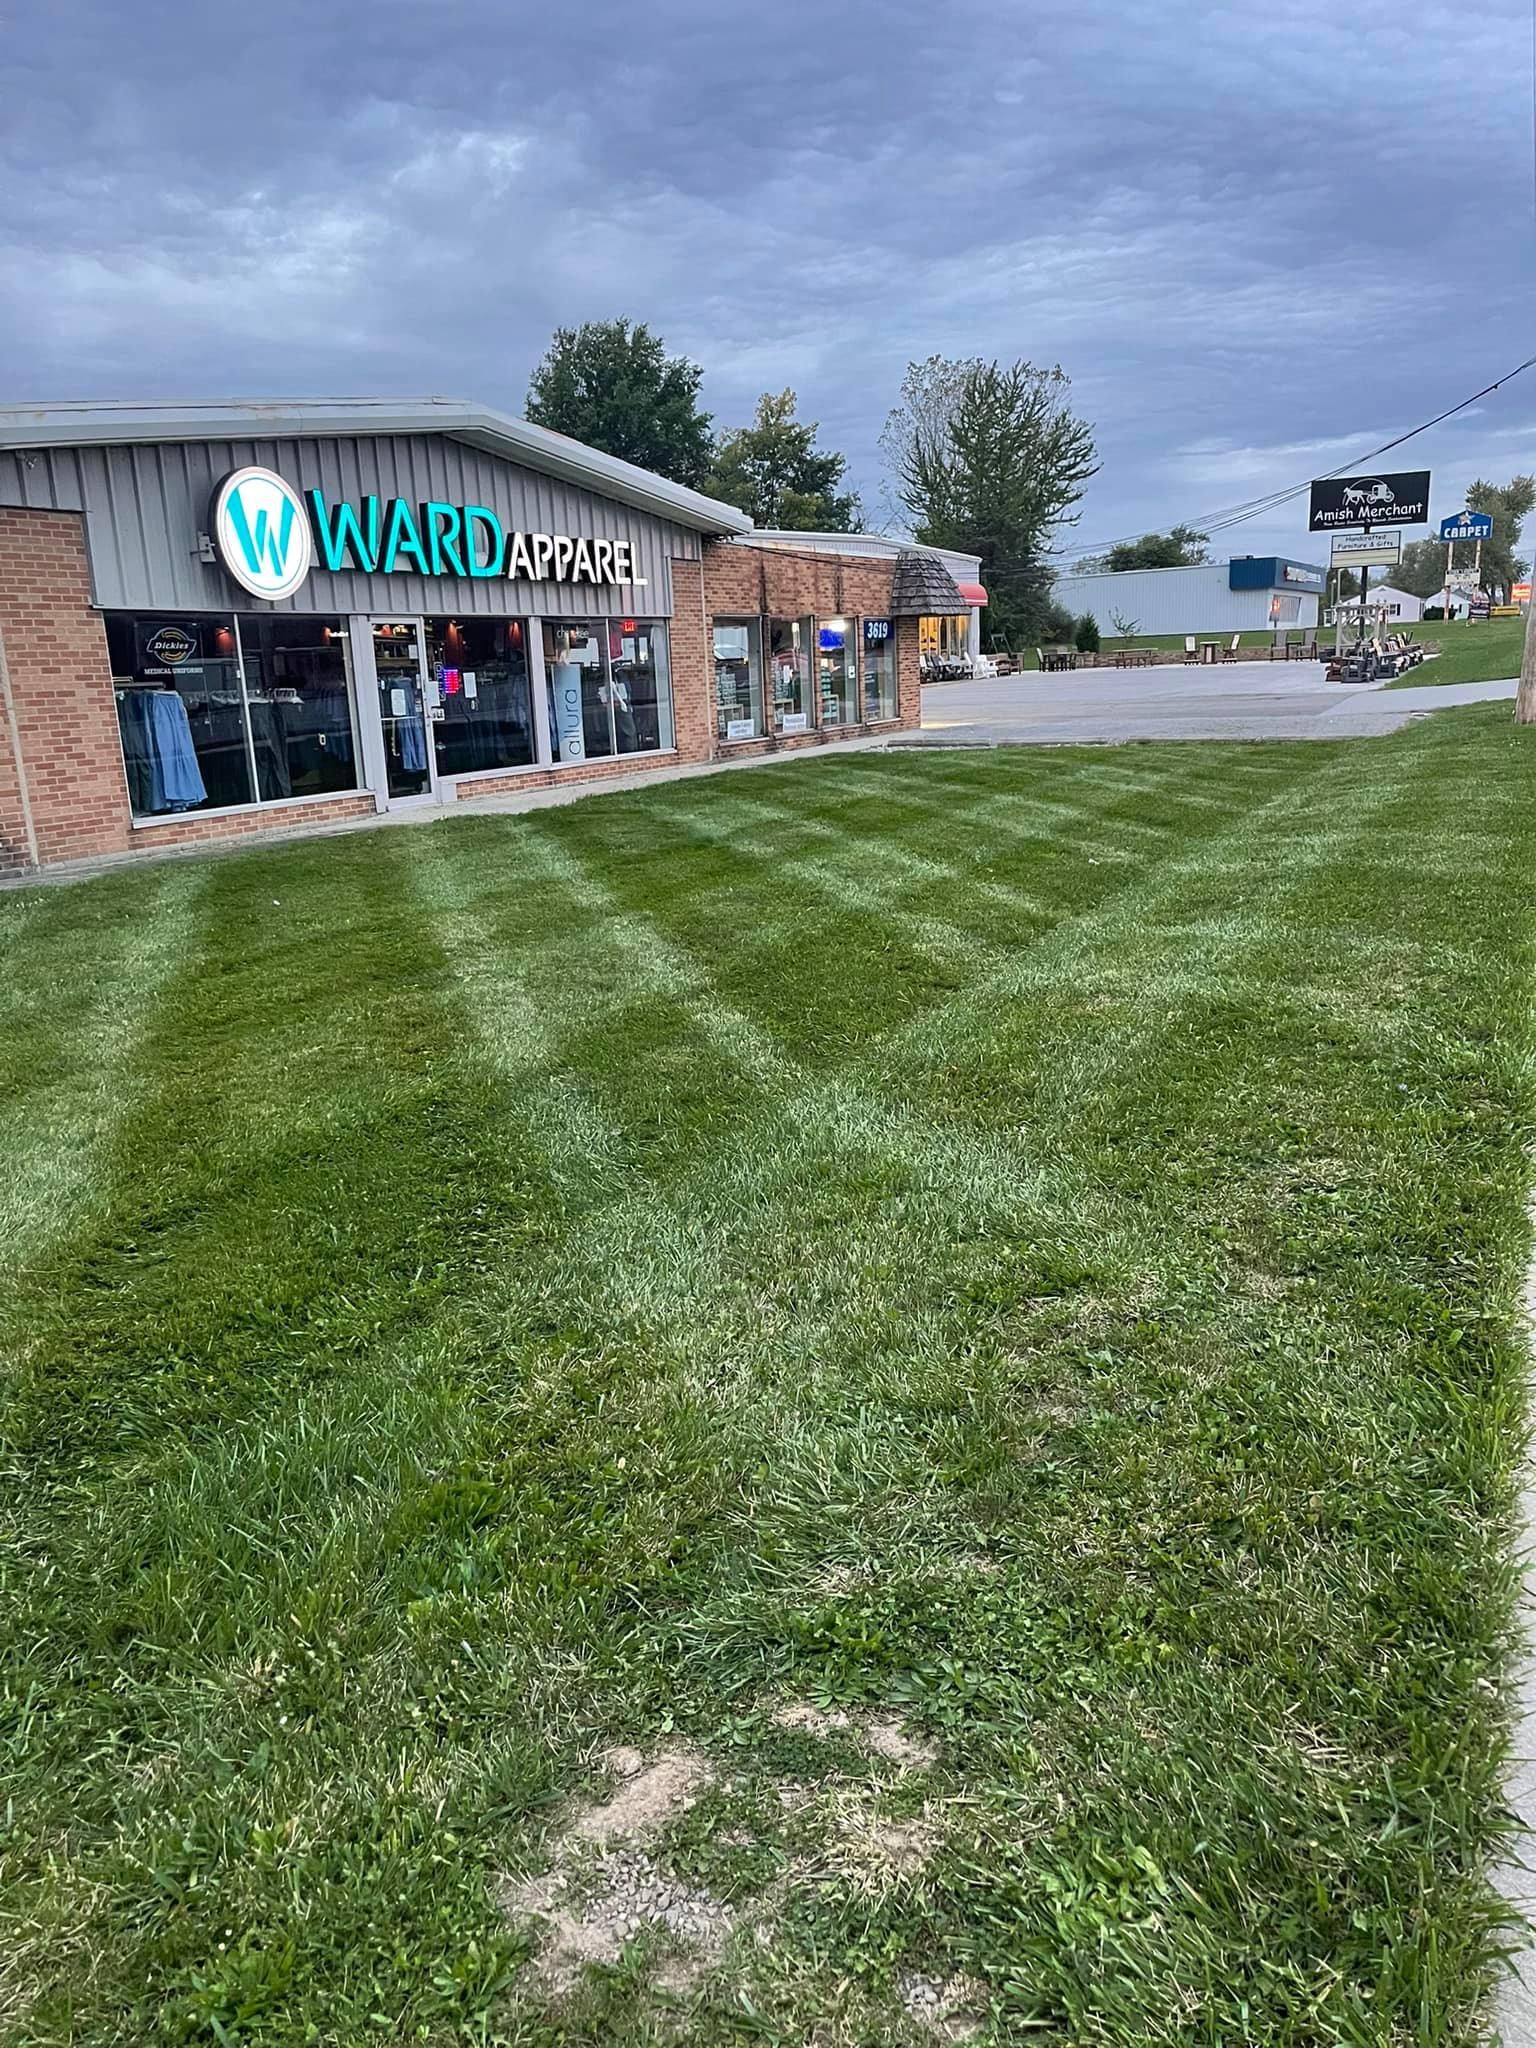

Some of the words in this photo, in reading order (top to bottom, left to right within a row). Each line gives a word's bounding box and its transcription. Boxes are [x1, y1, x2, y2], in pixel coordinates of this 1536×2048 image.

[1314, 507, 1353, 521] Amish
[1358, 502, 1423, 518] Merchant
[225, 487, 296, 577] W
[304, 488, 502, 578] WARD
[507, 531, 649, 586] APPAREL
[1345, 534, 1387, 542] Handcrafted
[1444, 525, 1489, 538] CARPET
[867, 622, 888, 639] 3619
[154, 641, 189, 650] Dickies
[144, 667, 172, 675] MEDICAL
[563, 689, 582, 755] allura
